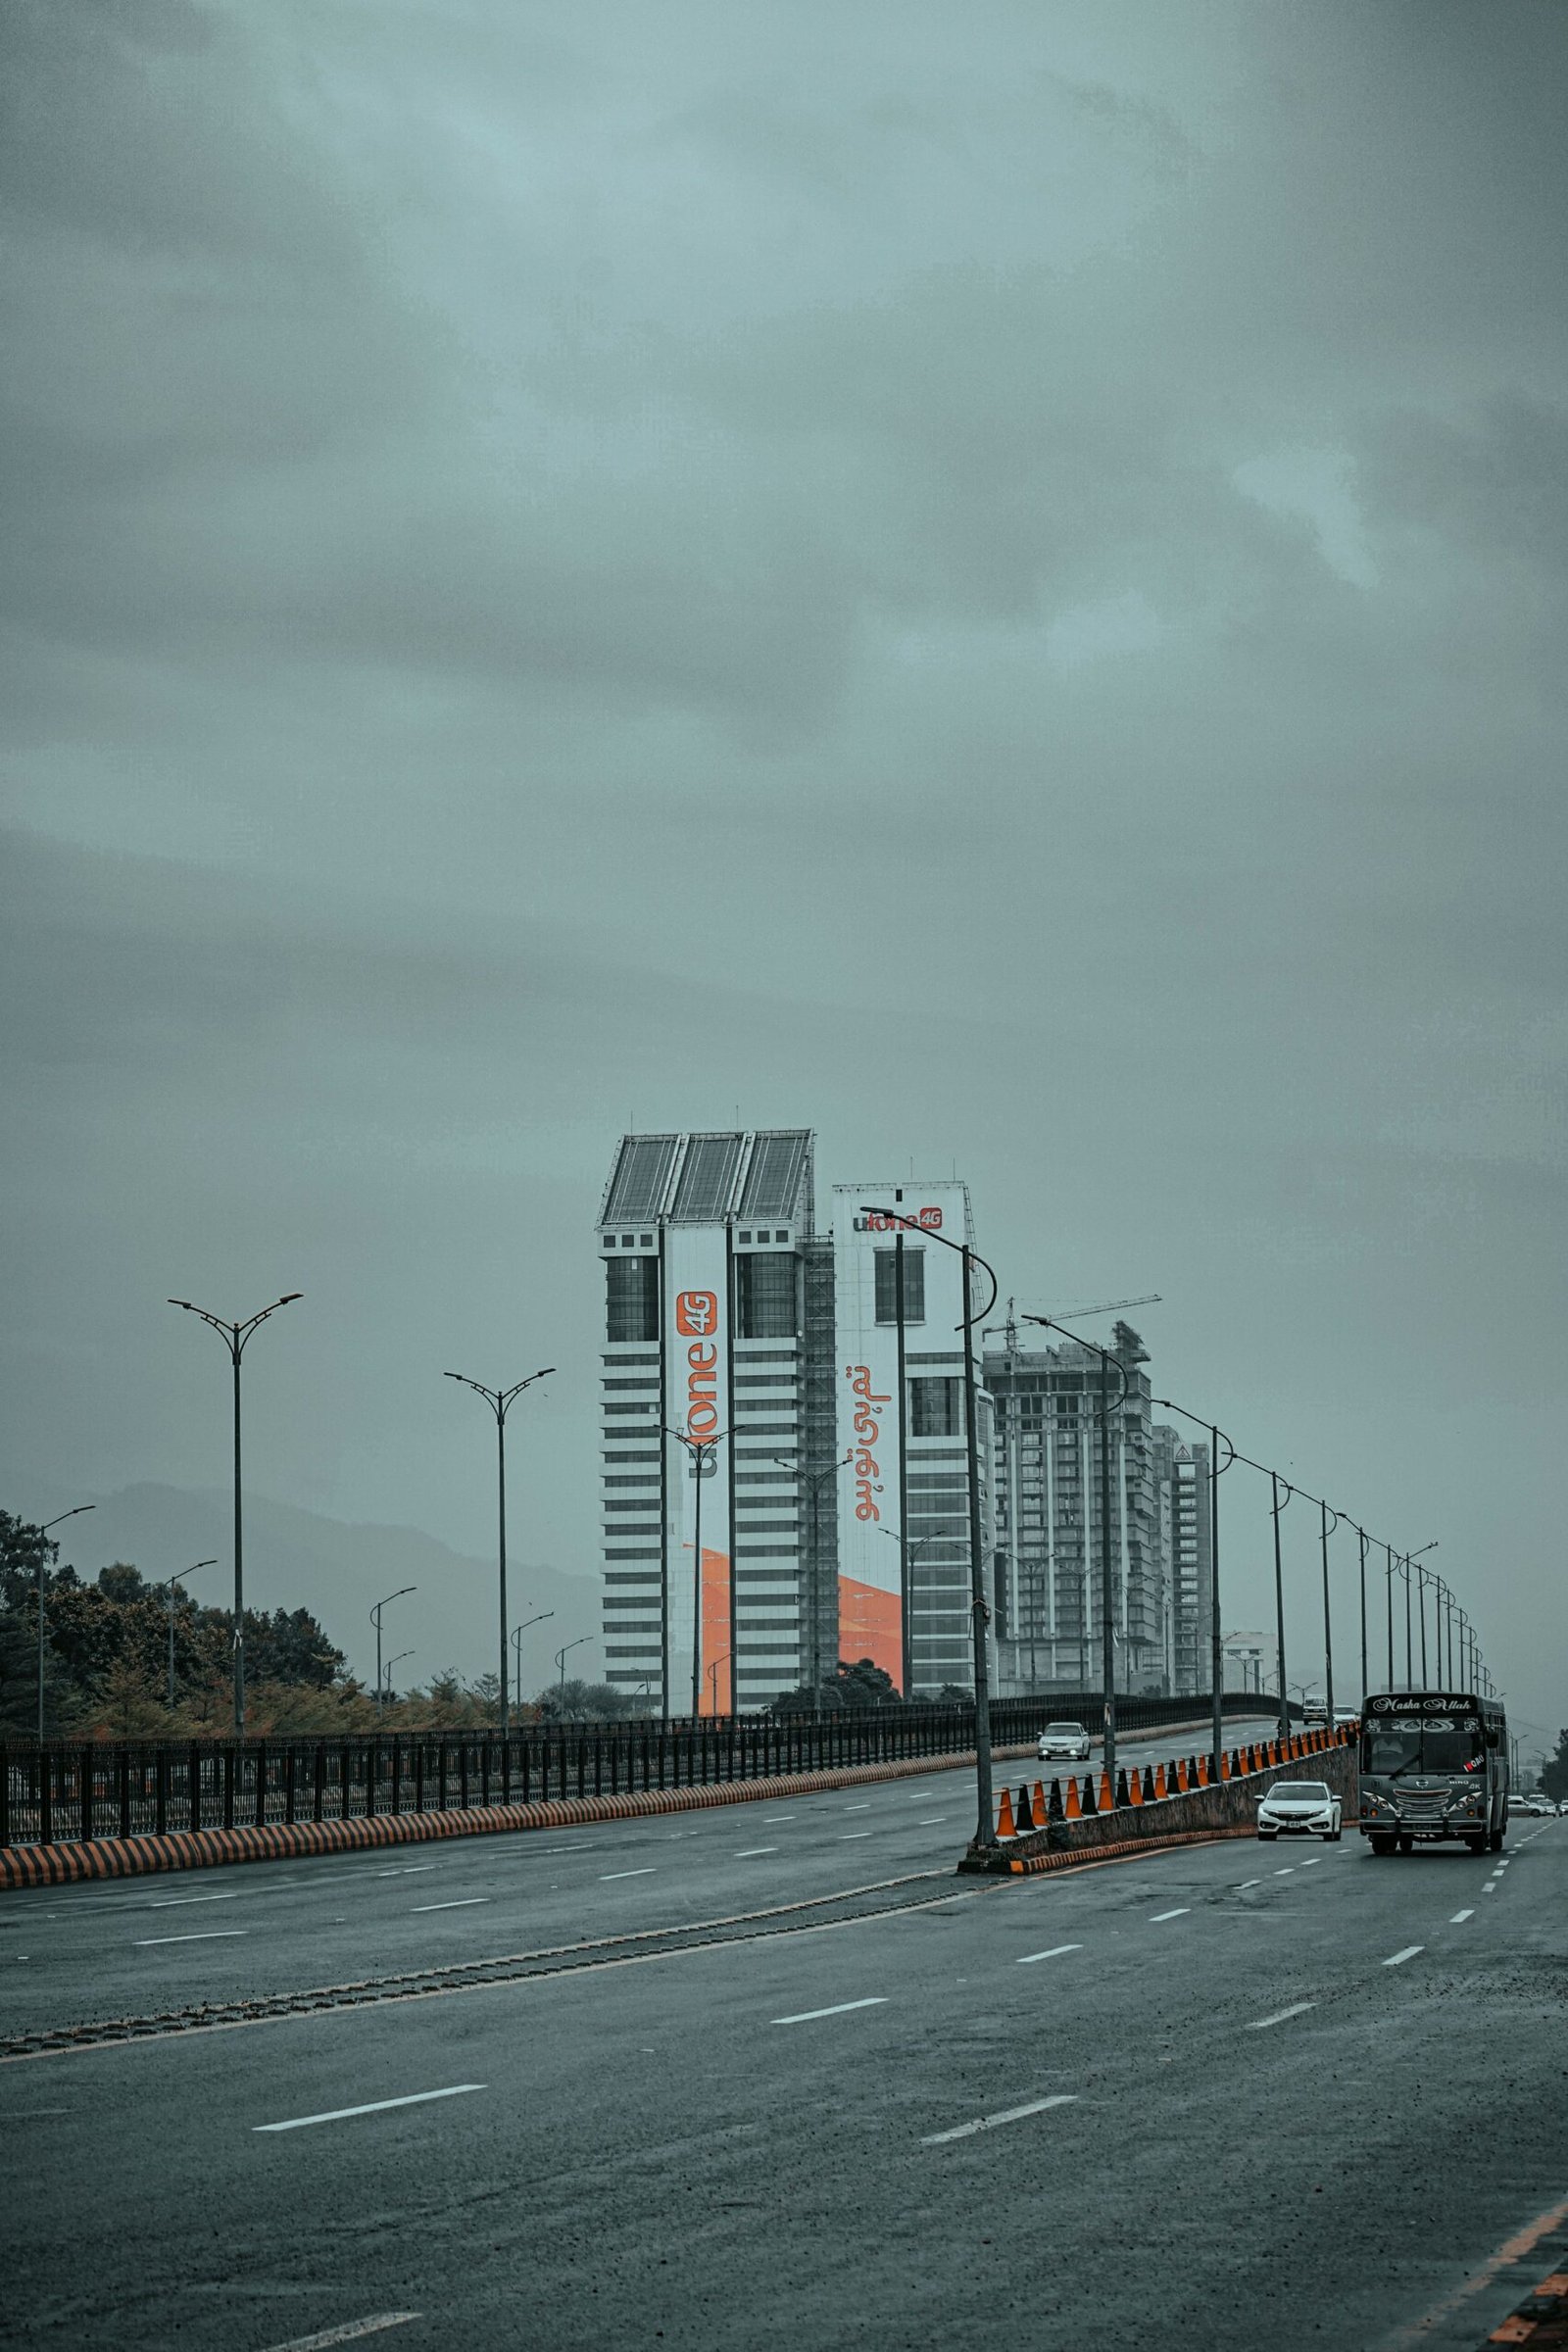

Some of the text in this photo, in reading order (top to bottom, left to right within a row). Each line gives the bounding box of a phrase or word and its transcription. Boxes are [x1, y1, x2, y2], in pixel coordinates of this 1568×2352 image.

[921, 1210, 941, 1225] 4G
[683, 1294, 712, 1336] 4G
[1372, 1697, 1471, 1712] Masha Allah
